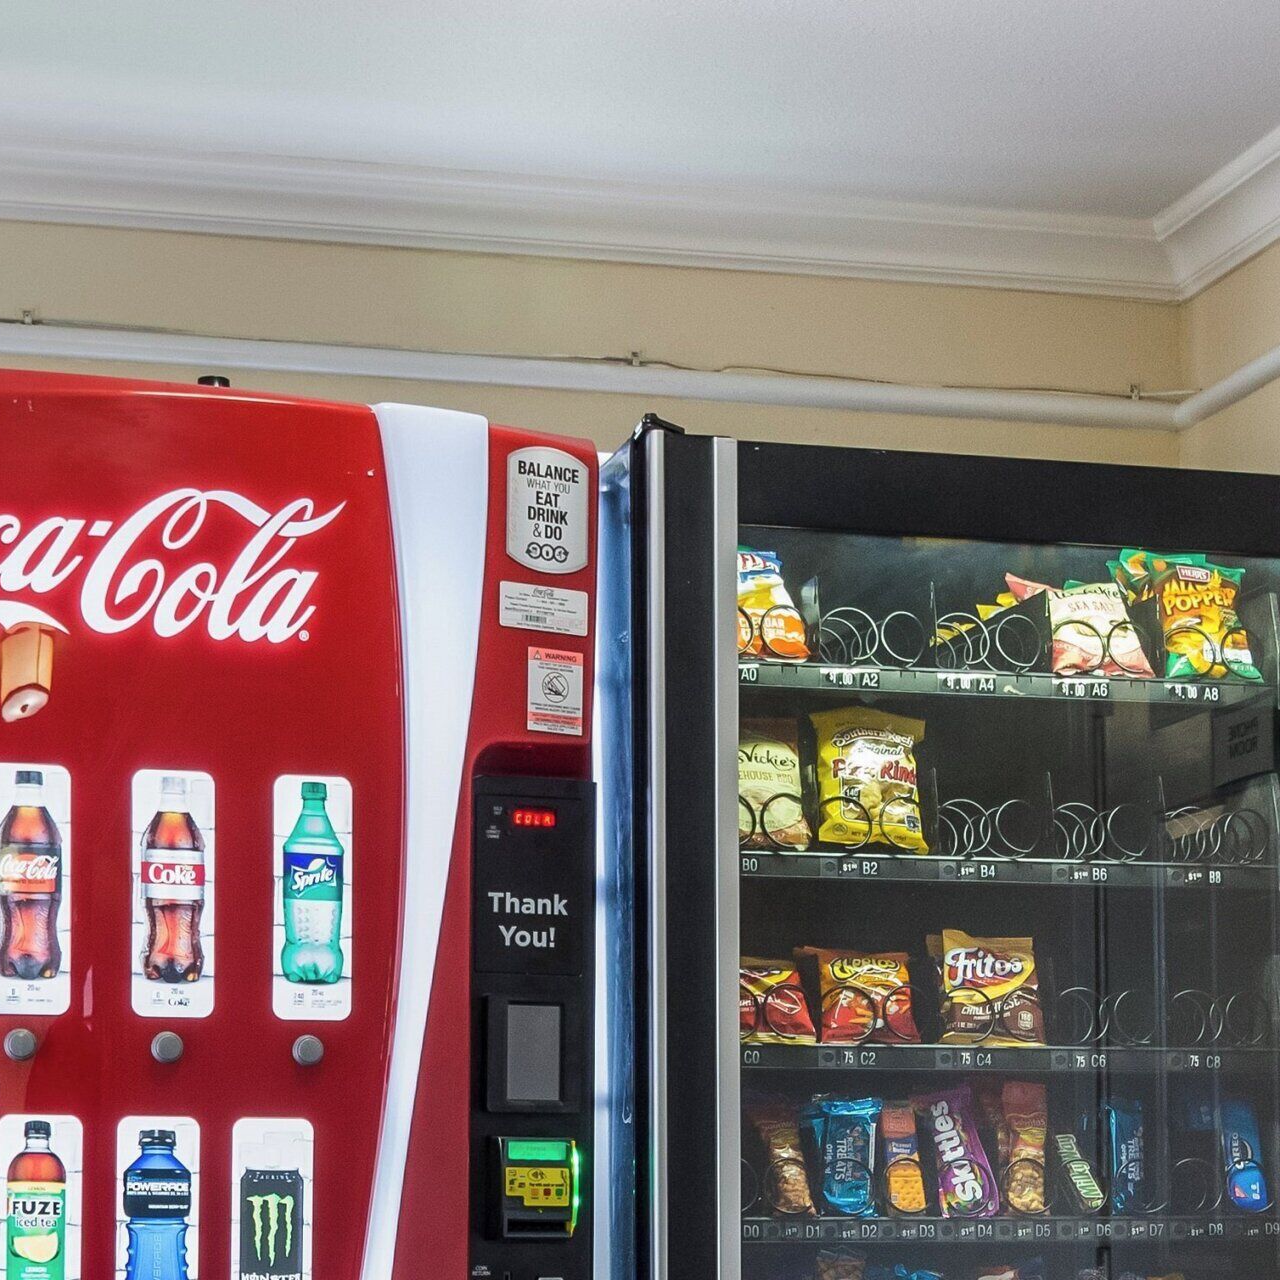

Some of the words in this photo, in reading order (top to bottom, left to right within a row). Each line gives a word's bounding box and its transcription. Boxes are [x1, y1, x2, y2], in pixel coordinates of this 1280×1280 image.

[518, 460, 579, 484] BALANCE
[526, 478, 551, 490] WHAT
[554, 481, 571, 494] YOU
[536, 491, 560, 508] EAT
[527, 506, 568, 526] DRINK
[533, 523, 542, 538] &
[544, 524, 562, 541] DO
[545, 652, 576, 662] WARNING
[741, 668, 757, 681] A0
[862, 674, 879, 686] A2
[979, 679, 994, 691] A4
[1092, 684, 1108, 697] A6
[1203, 688, 1219, 701] A8
[832, 727, 887, 746] Southern
[0, 852, 60, 879] Coca-Cola
[742, 859, 757, 871] B0
[863, 862, 878, 875] B2
[980, 866, 995, 877] B4
[148, 864, 196, 885] Coke
[291, 862, 334, 890] Sprite
[1092, 868, 1107, 881] B6
[1209, 871, 1221, 883] B8
[488, 892, 568, 915] Thank
[498, 925, 555, 948] You!
[945, 947, 1024, 987] Fritos
[744, 1051, 760, 1063] C0
[861, 1052, 876, 1065] C2
[976, 1053, 991, 1066] C4
[1091, 1054, 1106, 1067] C6
[1206, 1056, 1221, 1069] C8
[126, 1182, 190, 1192] POWERADE
[12, 1200, 61, 1216] FUZE
[16, 1216, 37, 1228] iced
[40, 1217, 57, 1228] tea
[1265, 1222, 1280, 1235] D9
[743, 1225, 759, 1238] D0
[806, 1225, 820, 1238] D1
[862, 1225, 877, 1238] D2
[920, 1225, 935, 1237] D3
[977, 1225, 993, 1237] D4
[1036, 1225, 1051, 1237] D5
[1097, 1224, 1111, 1236] D6
[1150, 1224, 1164, 1236] D7
[1209, 1223, 1223, 1235] D8
